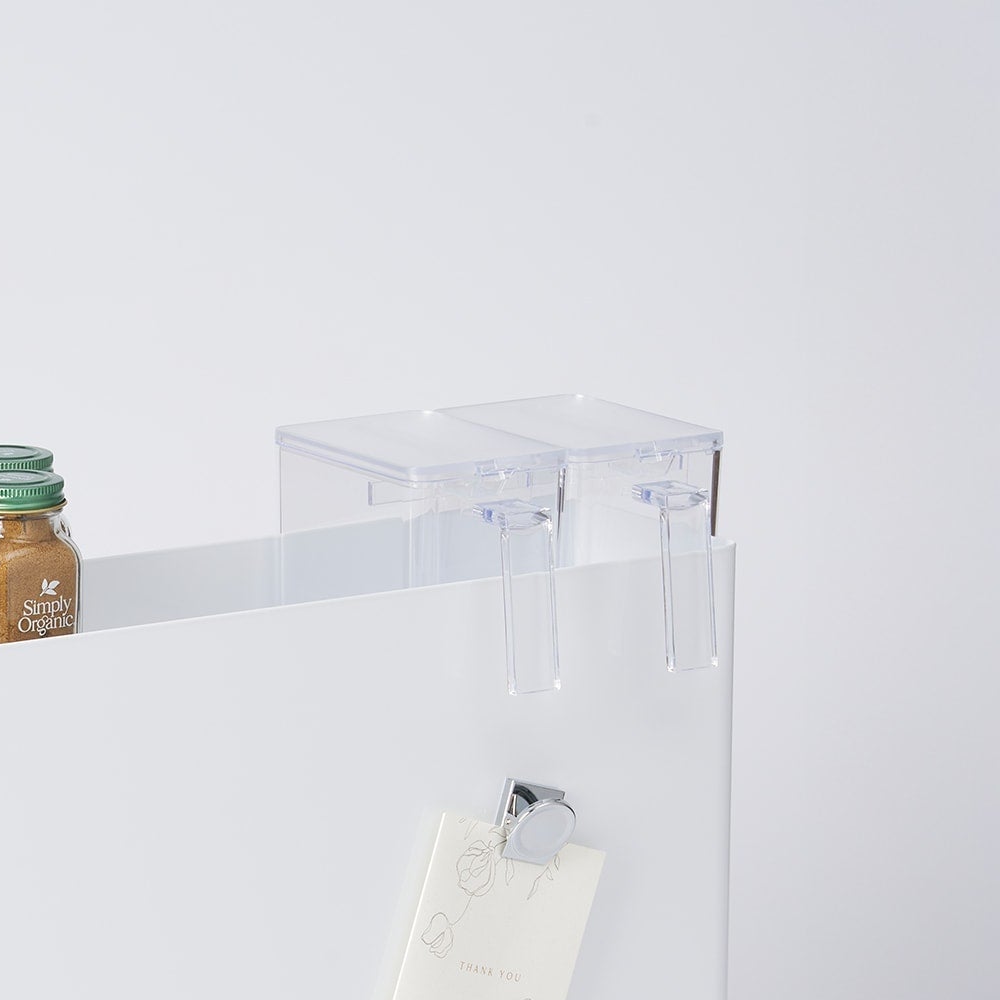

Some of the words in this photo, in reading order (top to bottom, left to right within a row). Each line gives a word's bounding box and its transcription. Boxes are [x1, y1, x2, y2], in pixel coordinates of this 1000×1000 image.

[23, 596, 72, 616] Simply
[18, 614, 74, 636] Organic
[460, 961, 492, 976] THANK
[499, 970, 522, 983] YOU
